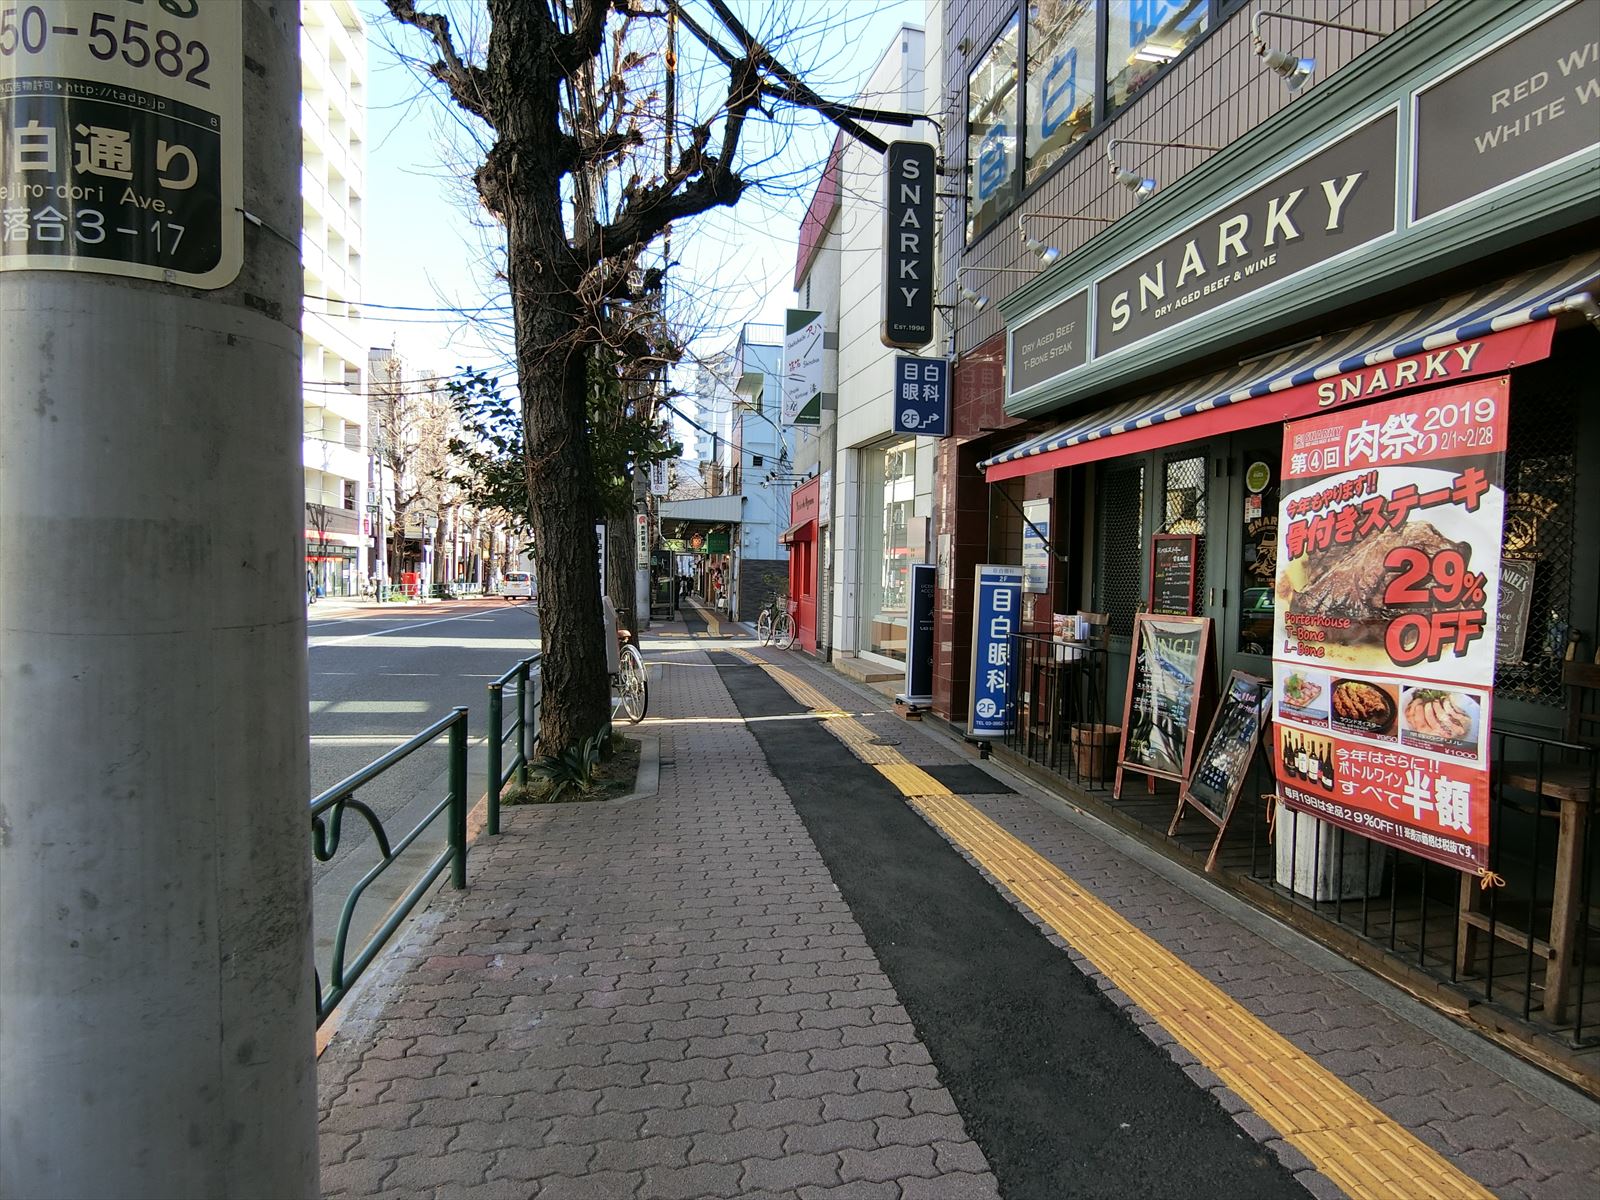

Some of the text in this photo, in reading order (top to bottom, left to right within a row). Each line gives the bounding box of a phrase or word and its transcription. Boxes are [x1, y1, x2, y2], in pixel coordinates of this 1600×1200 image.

[65, 82, 166, 111] http://tadp.jp
[1491, 71, 1549, 114] RED
[210, 117, 218, 126] 8
[1474, 97, 1566, 154] WHITE
[13, 120, 199, 190] 白通り
[120, 187, 173, 215] Ave.
[900, 159, 920, 307] SNARKY
[1111, 172, 1362, 332] SNARKY
[1155, 253, 1276, 318] DRY AGED BEEF & WINE
[904, 363, 939, 381] 目白
[1317, 342, 1481, 407] SNARKY
[902, 383, 940, 402] 眼科
[903, 413, 918, 423] 2F
[1423, 398, 1495, 431] 2019
[1345, 413, 1437, 466] 肉祭り
[1287, 467, 1488, 559] 骨付きステーキ
[1384, 547, 1486, 605] 29%
[1284, 611, 1351, 629] Porterhouse
[1285, 625, 1325, 642] T-Bone
[986, 588, 1011, 693] 目白眼科
[1142, 636, 1195, 655] LNCH
[1284, 640, 1325, 658] L-Bone
[1385, 610, 1485, 664] OFF
[978, 703, 994, 713] 2F
[1338, 761, 1402, 788] ボトルワイン
[1338, 779, 1402, 809] すべて
[1402, 768, 1472, 834] 半額
